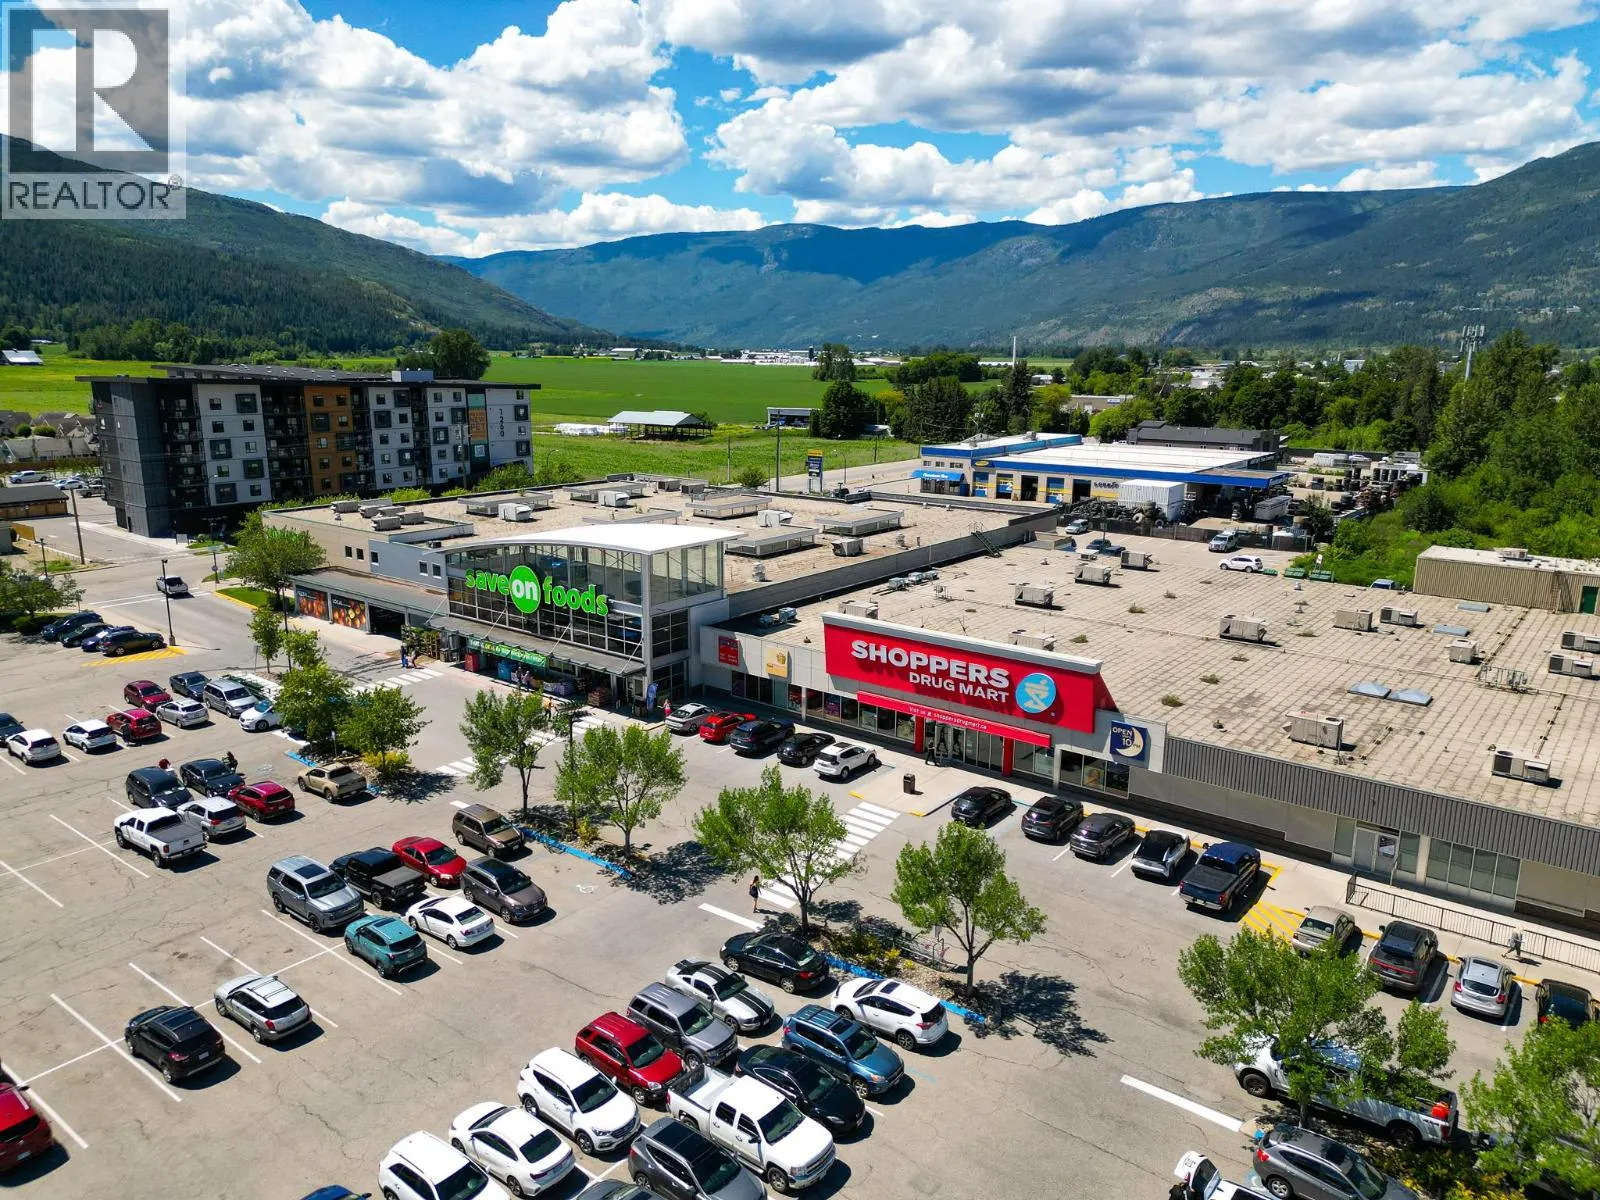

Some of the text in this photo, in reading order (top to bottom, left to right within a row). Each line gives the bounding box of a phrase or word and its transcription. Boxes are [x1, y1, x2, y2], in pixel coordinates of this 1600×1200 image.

[464, 568, 609, 617] save on foods
[850, 639, 1010, 689] SHOPPERS
[908, 671, 1010, 704] DRUG MART
[1112, 726, 1133, 736] OPEN
[1122, 737, 1132, 747] 10
